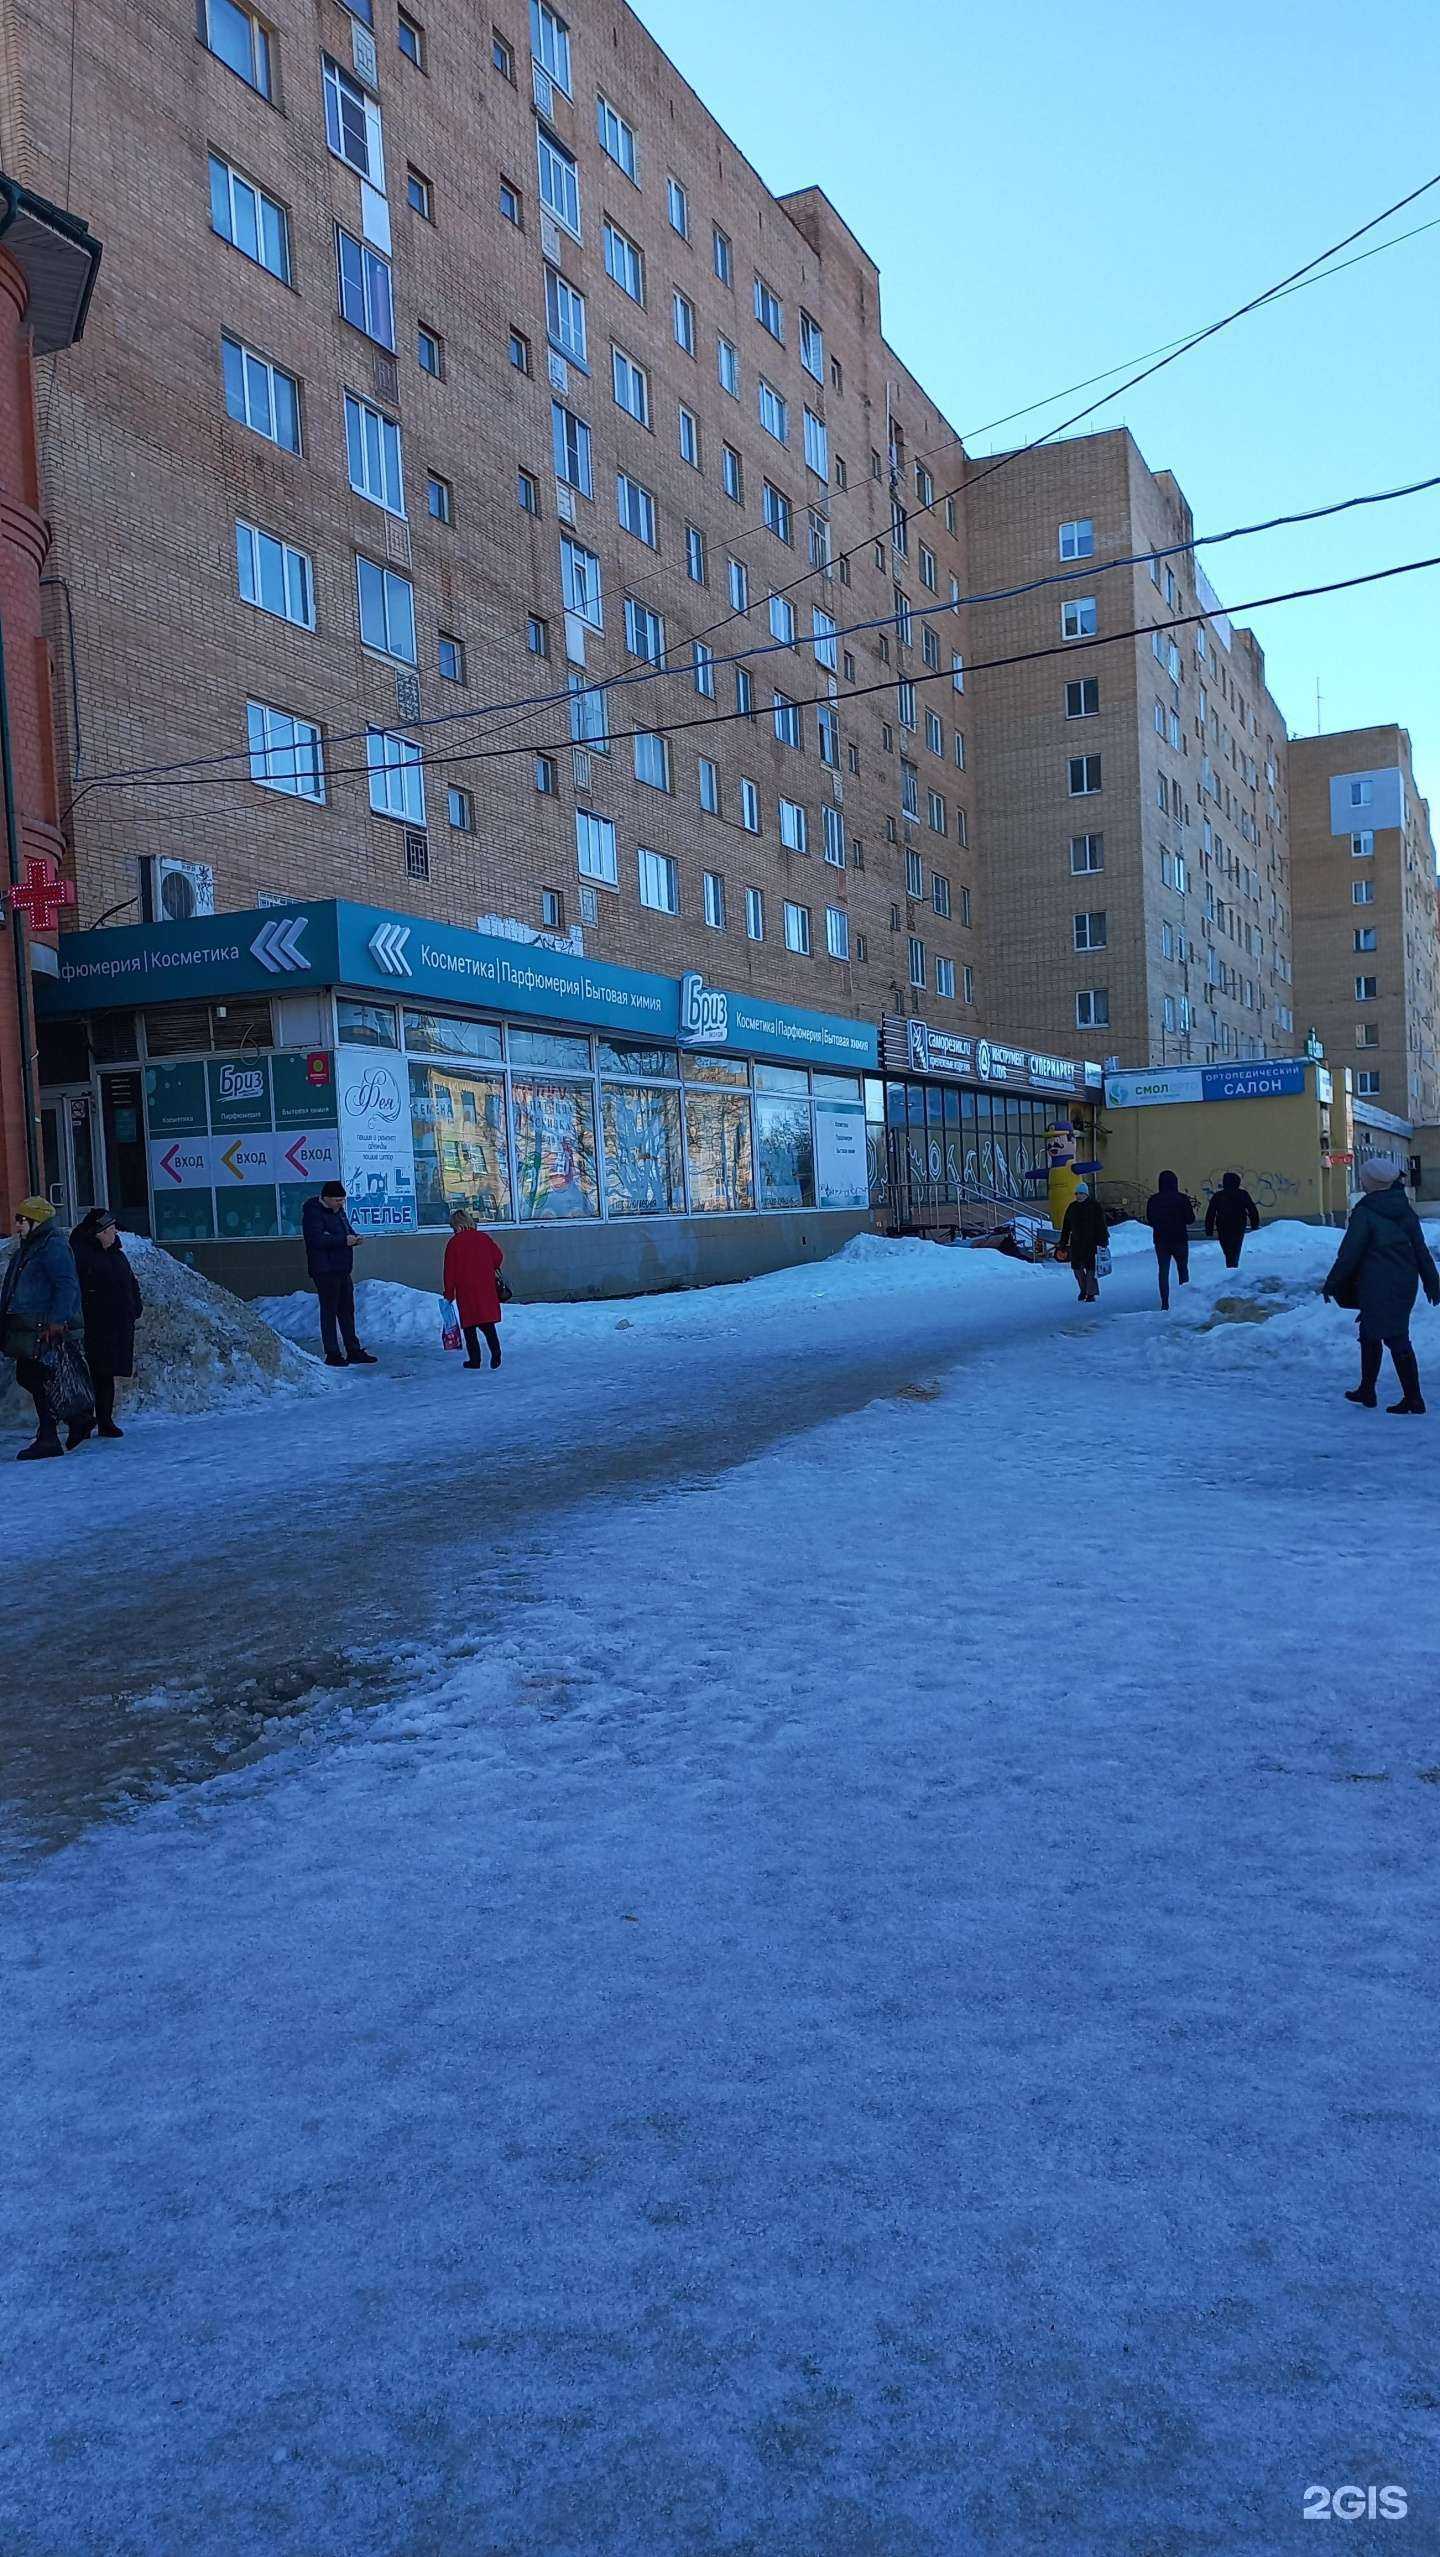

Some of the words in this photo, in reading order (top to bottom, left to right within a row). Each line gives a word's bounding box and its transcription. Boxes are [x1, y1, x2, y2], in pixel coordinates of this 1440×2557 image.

[151, 945, 240, 969] Косметика
[420, 943, 495, 979] Косметика
[501, 961, 580, 995] Парфюмерия
[585, 979, 628, 1006] Бытовая
[630, 993, 662, 1013] химия
[687, 974, 728, 1037] Бриз
[736, 1011, 775, 1033] Косметика
[778, 1021, 822, 1043] Парфюмерия
[1029, 1055, 1075, 1081] СУПЕРМАРКЕТ
[1205, 1065, 1300, 1082] ОРТОПЕДИЧЕСКИЙ
[219, 1064, 264, 1098] Бриз
[1223, 1079, 1282, 1096] САЛОН
[174, 1154, 204, 1169] ВХОД
[236, 1151, 267, 1166] ВХОД
[300, 1147, 332, 1162] ВХОД
[350, 1206, 412, 1225] АТЕЛЬЕ
